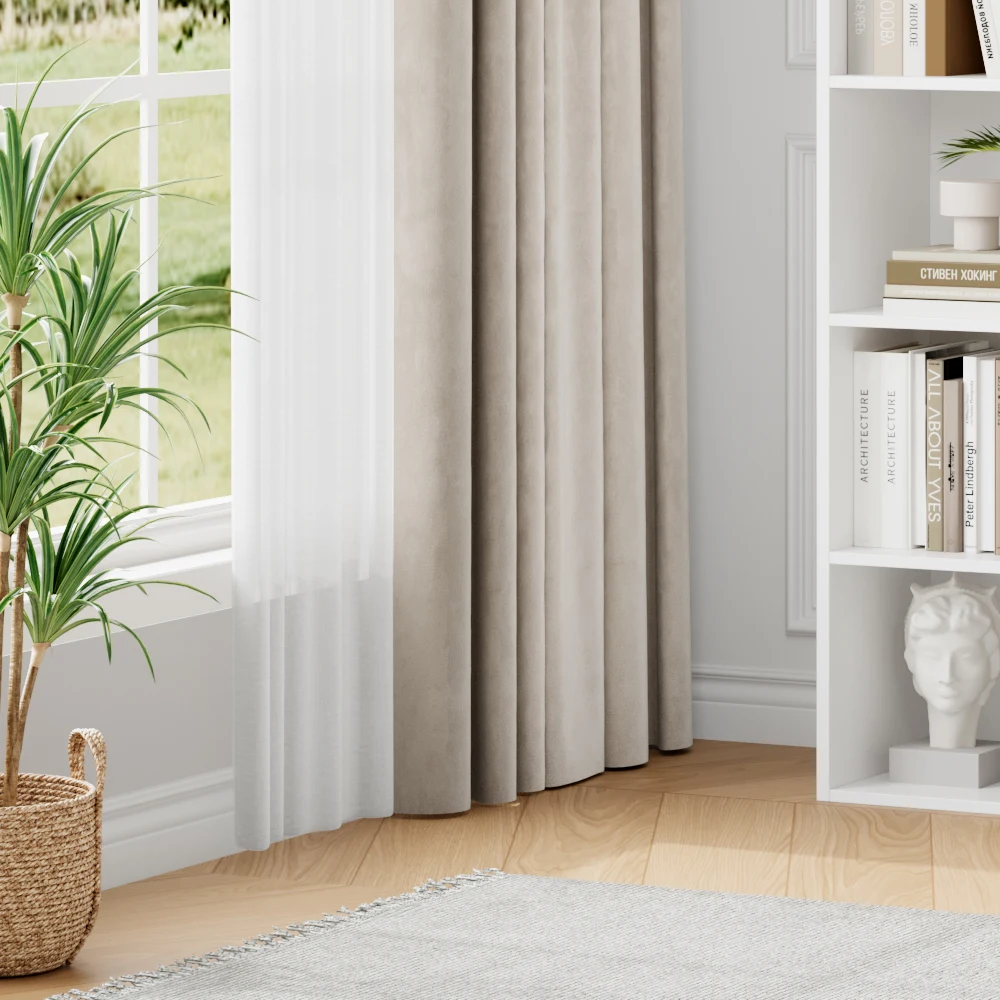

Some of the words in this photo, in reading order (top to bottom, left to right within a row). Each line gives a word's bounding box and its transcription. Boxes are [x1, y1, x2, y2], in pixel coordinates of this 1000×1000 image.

[920, 267, 958, 281] СТИВЕН
[960, 269, 998, 282] ХОКИНГ
[928, 368, 941, 401] ALL
[860, 388, 869, 483] ARCHITECTURE
[887, 390, 896, 485] ARCHITECTURE
[928, 407, 941, 470] ABOUT
[965, 440, 977, 496] Lindbergh
[928, 478, 941, 523] YVES
[965, 498, 974, 528] Peter
